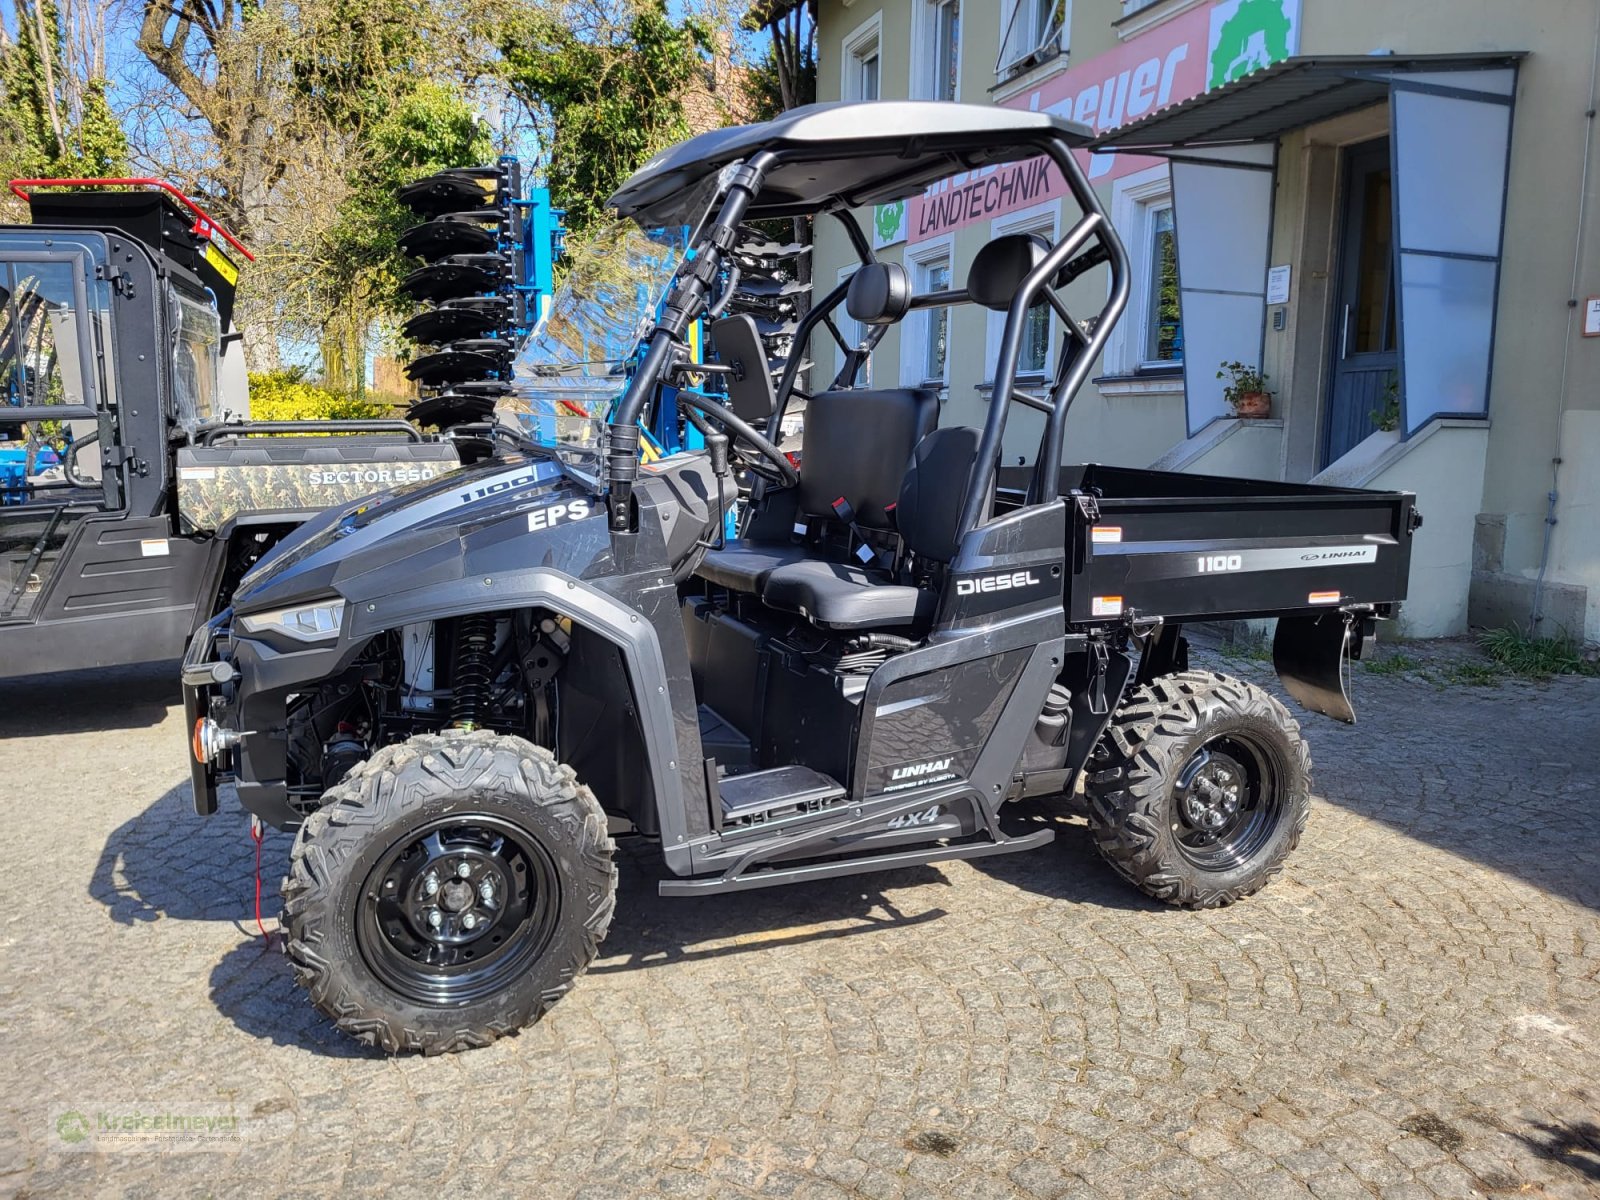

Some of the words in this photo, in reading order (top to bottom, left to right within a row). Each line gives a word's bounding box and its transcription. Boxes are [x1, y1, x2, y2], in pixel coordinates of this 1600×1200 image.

[919, 157, 1052, 235] LANDTECHNIK
[309, 470, 393, 485] SECTOR
[395, 469, 434, 482] 550
[461, 475, 535, 502] 1100
[527, 499, 590, 532] EPS
[1198, 555, 1242, 572] 1100
[1321, 550, 1366, 559] LINHAI
[957, 571, 1039, 595] DIESEL
[891, 758, 952, 780] LINHAI
